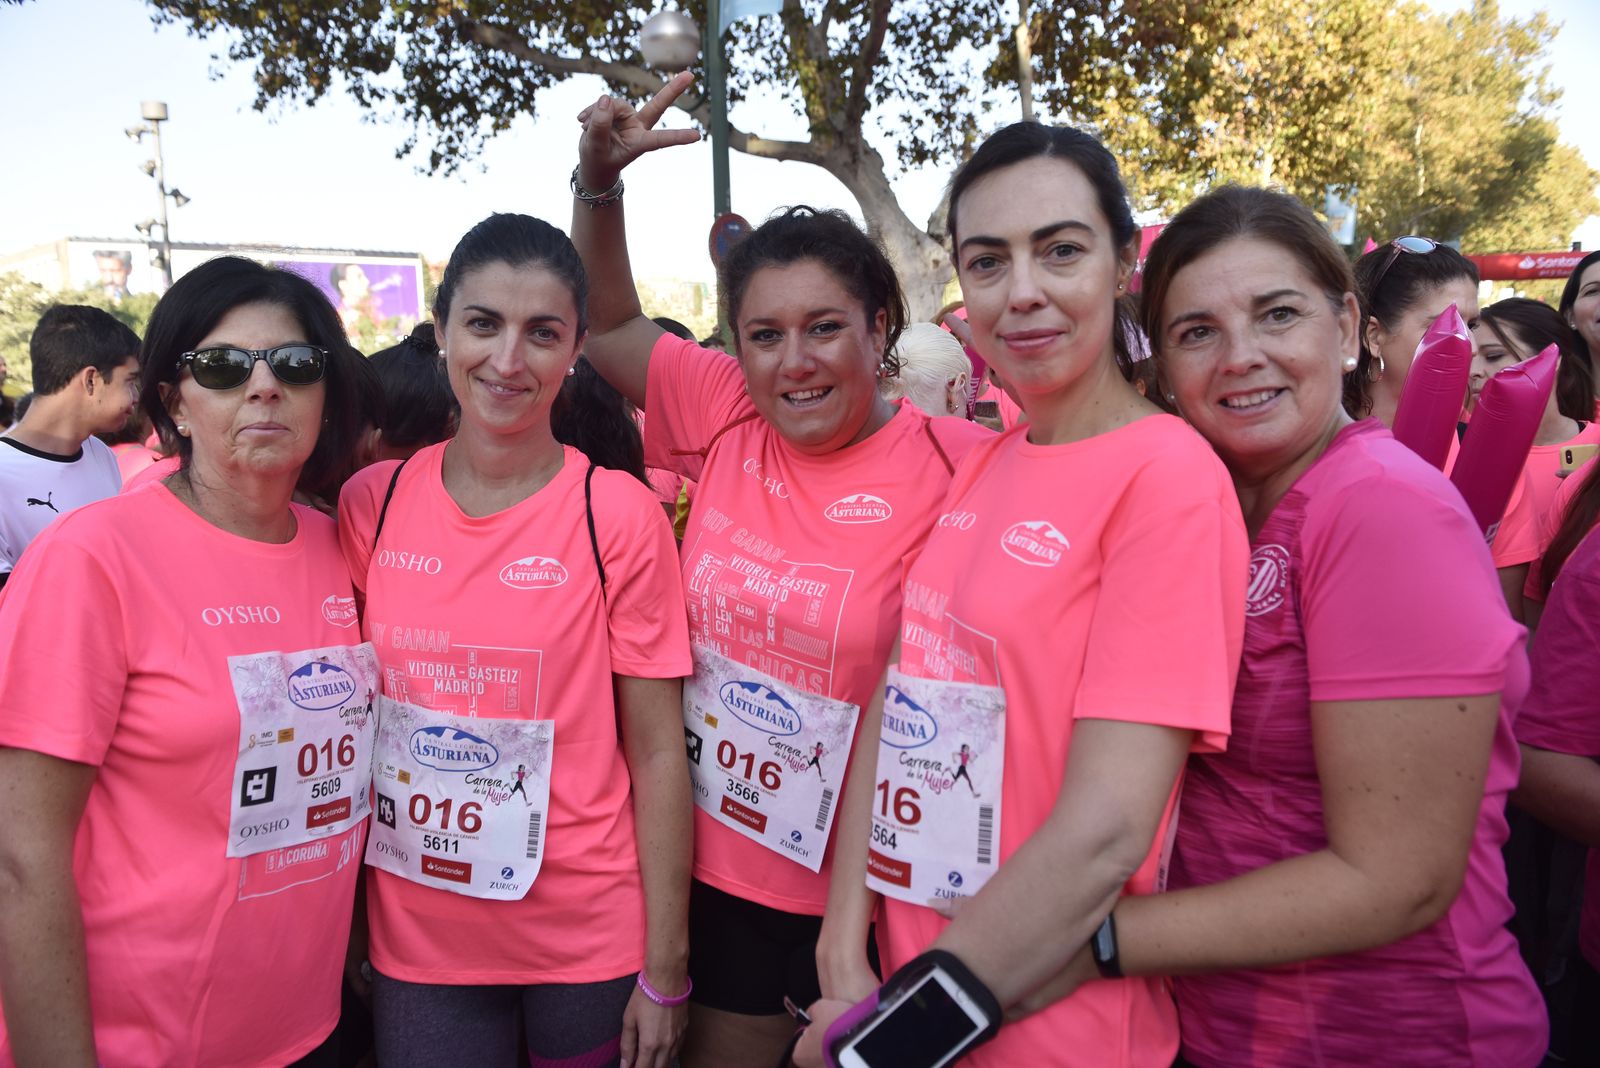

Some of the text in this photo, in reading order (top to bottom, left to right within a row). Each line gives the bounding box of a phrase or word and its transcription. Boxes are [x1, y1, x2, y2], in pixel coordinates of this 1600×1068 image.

[829, 506, 887, 518] ASTURIANA
[730, 527, 786, 564] GANAN
[378, 550, 442, 575] OYSHO
[504, 568, 562, 582] ASTURIANA
[731, 556, 771, 581] VITORIA
[779, 576, 826, 598] GASTEIZ
[743, 576, 789, 602] MADRID
[201, 605, 281, 626] OYSHO
[392, 626, 450, 653] GANAN
[740, 625, 764, 648] LAS
[408, 661, 456, 678] VITORIA
[468, 666, 519, 684] GASTEIZ
[746, 650, 823, 697] CHICAS
[293, 680, 352, 702] ASTURIANA
[434, 679, 485, 694] MADRID
[724, 687, 794, 731] ASTURIANA
[883, 712, 927, 739] URIANA
[297, 734, 355, 777] 016
[412, 737, 490, 764] ASTURIANA
[717, 739, 783, 791] 016
[899, 751, 942, 773] Carrera
[311, 777, 341, 798] 5609
[464, 773, 502, 787] Carrera
[486, 789, 512, 805] Mujer
[726, 778, 760, 805] 3566
[877, 779, 922, 826] 16
[321, 805, 347, 819] Santander
[408, 793, 483, 834] 016
[733, 806, 761, 826] Santander
[240, 818, 289, 838] OYSHO
[286, 840, 328, 864] CORUÑA
[376, 841, 408, 863] OYSHO
[423, 834, 459, 854] 5611
[779, 838, 809, 858] ZURICH
[434, 864, 465, 877] Santander
[489, 881, 519, 891] ZURICH
